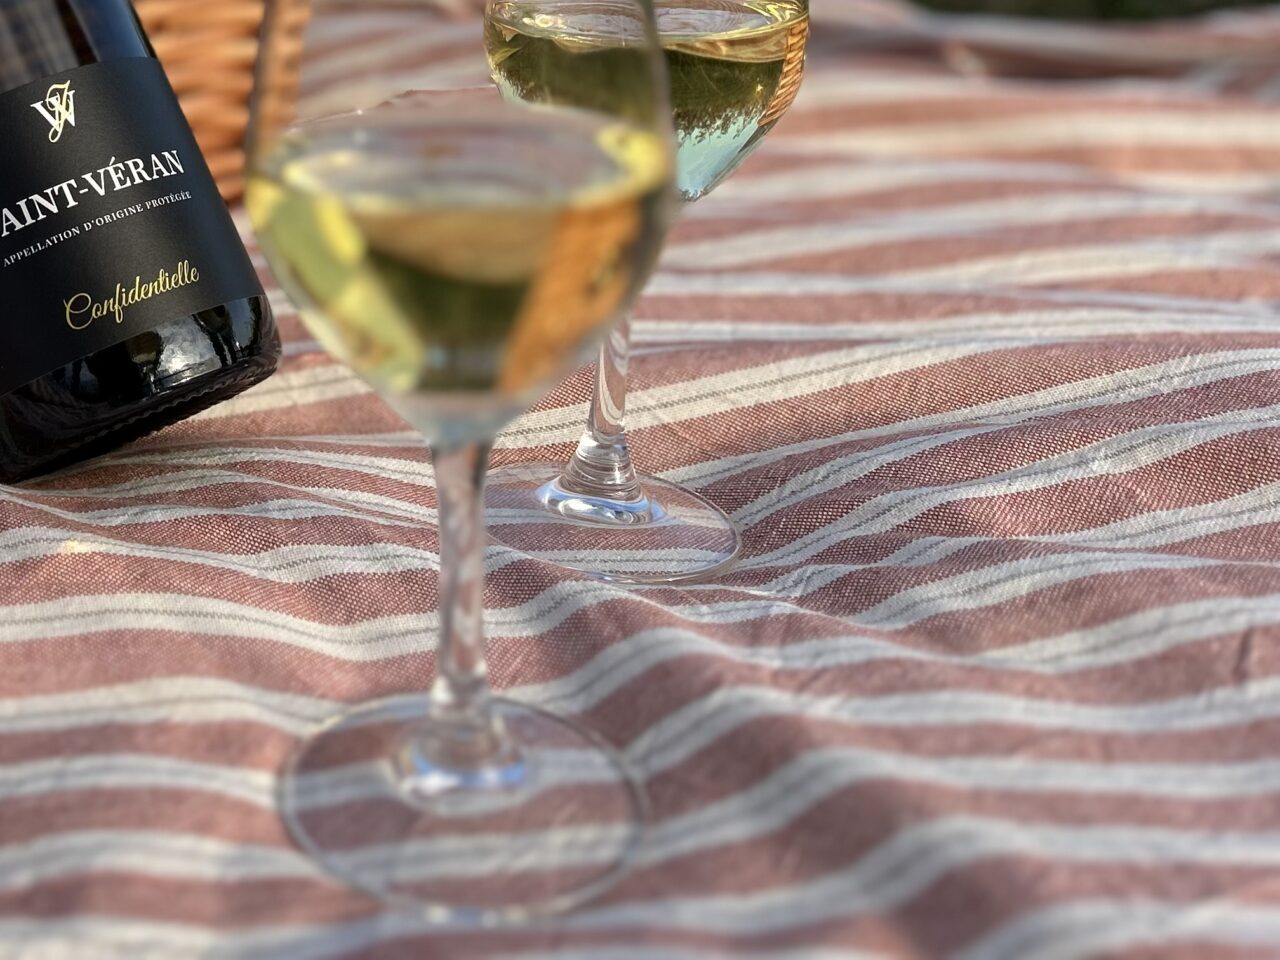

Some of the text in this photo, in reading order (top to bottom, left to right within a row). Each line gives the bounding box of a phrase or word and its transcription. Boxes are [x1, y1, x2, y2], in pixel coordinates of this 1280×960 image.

[3, 190, 192, 268] APPELLATION D'ORIGINE PROTÉGÉE
[63, 259, 200, 330] Confidentielle
